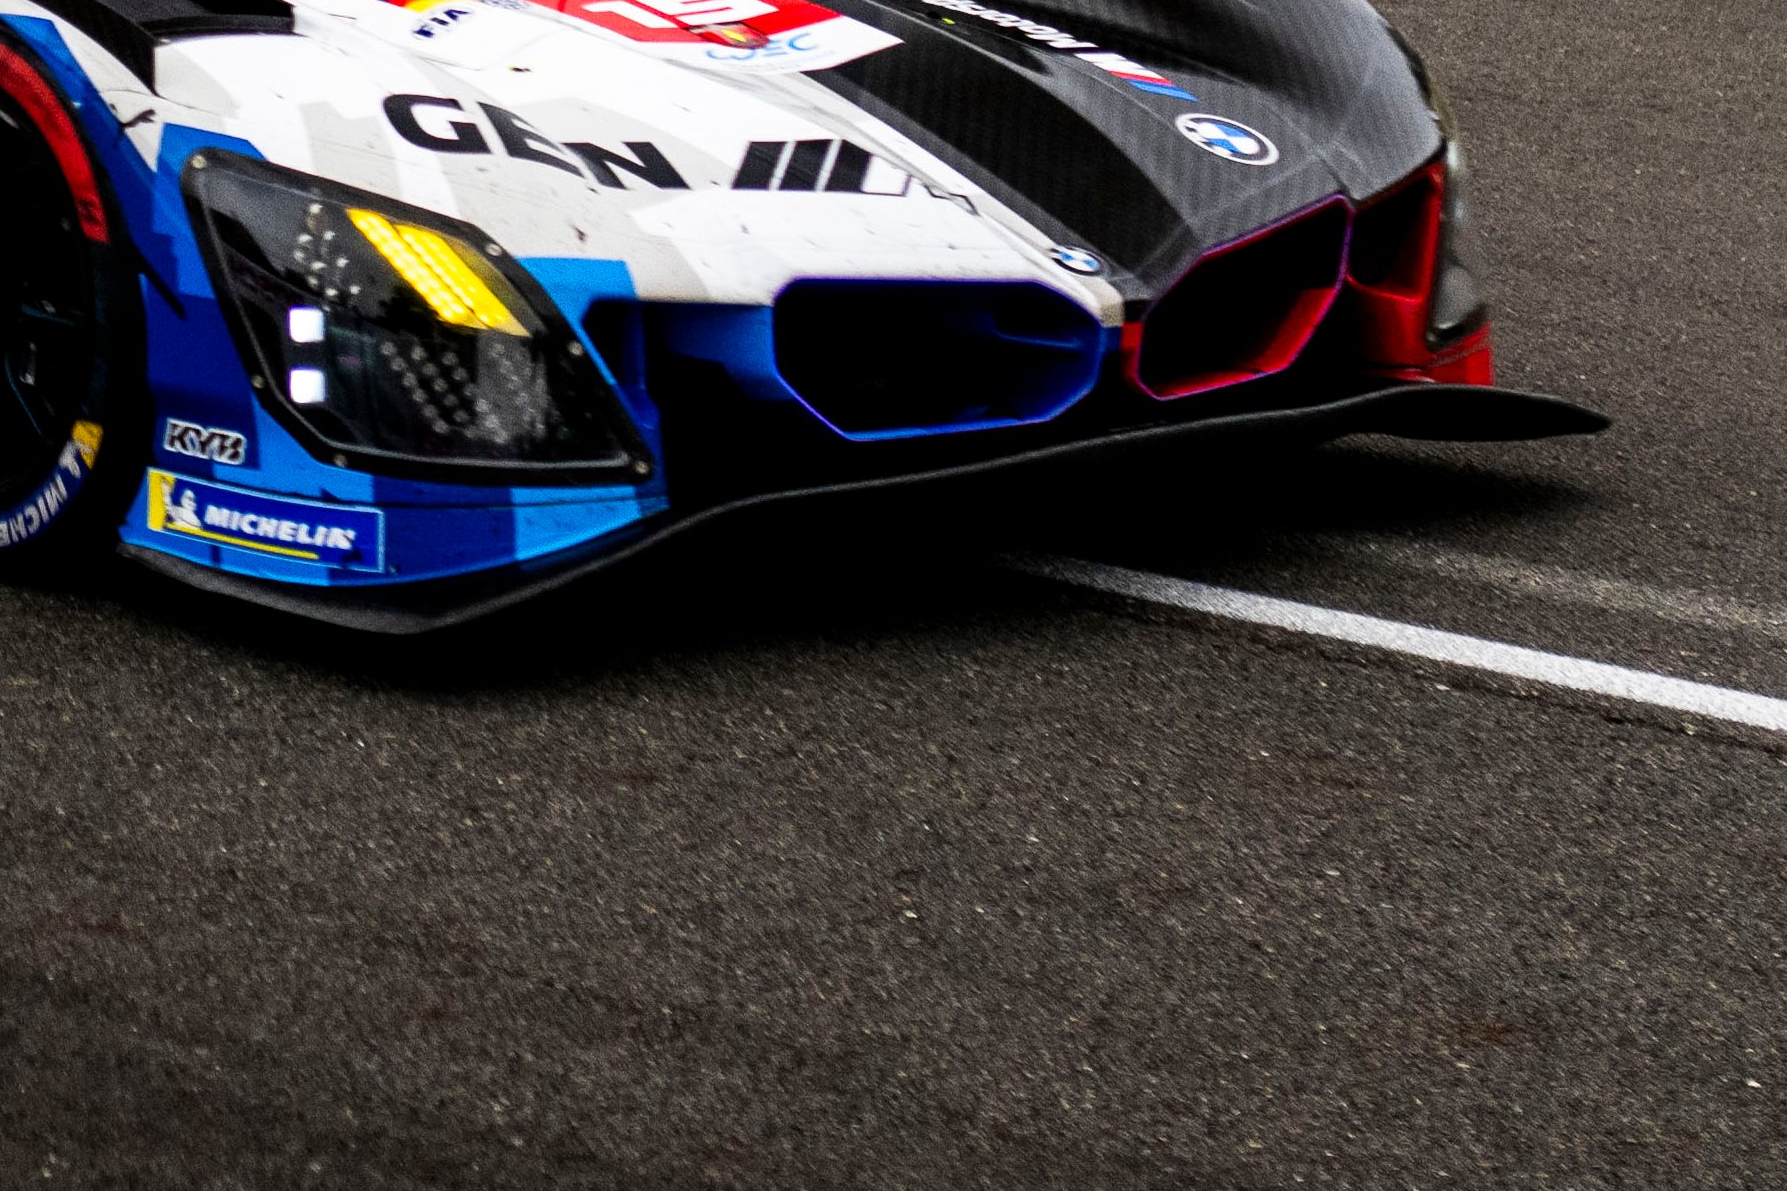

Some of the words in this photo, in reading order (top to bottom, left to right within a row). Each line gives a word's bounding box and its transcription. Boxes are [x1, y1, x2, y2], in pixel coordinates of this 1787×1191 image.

[382, 93, 692, 190] GEN
[166, 420, 246, 464] KYB
[204, 504, 356, 551] MICHELIN
